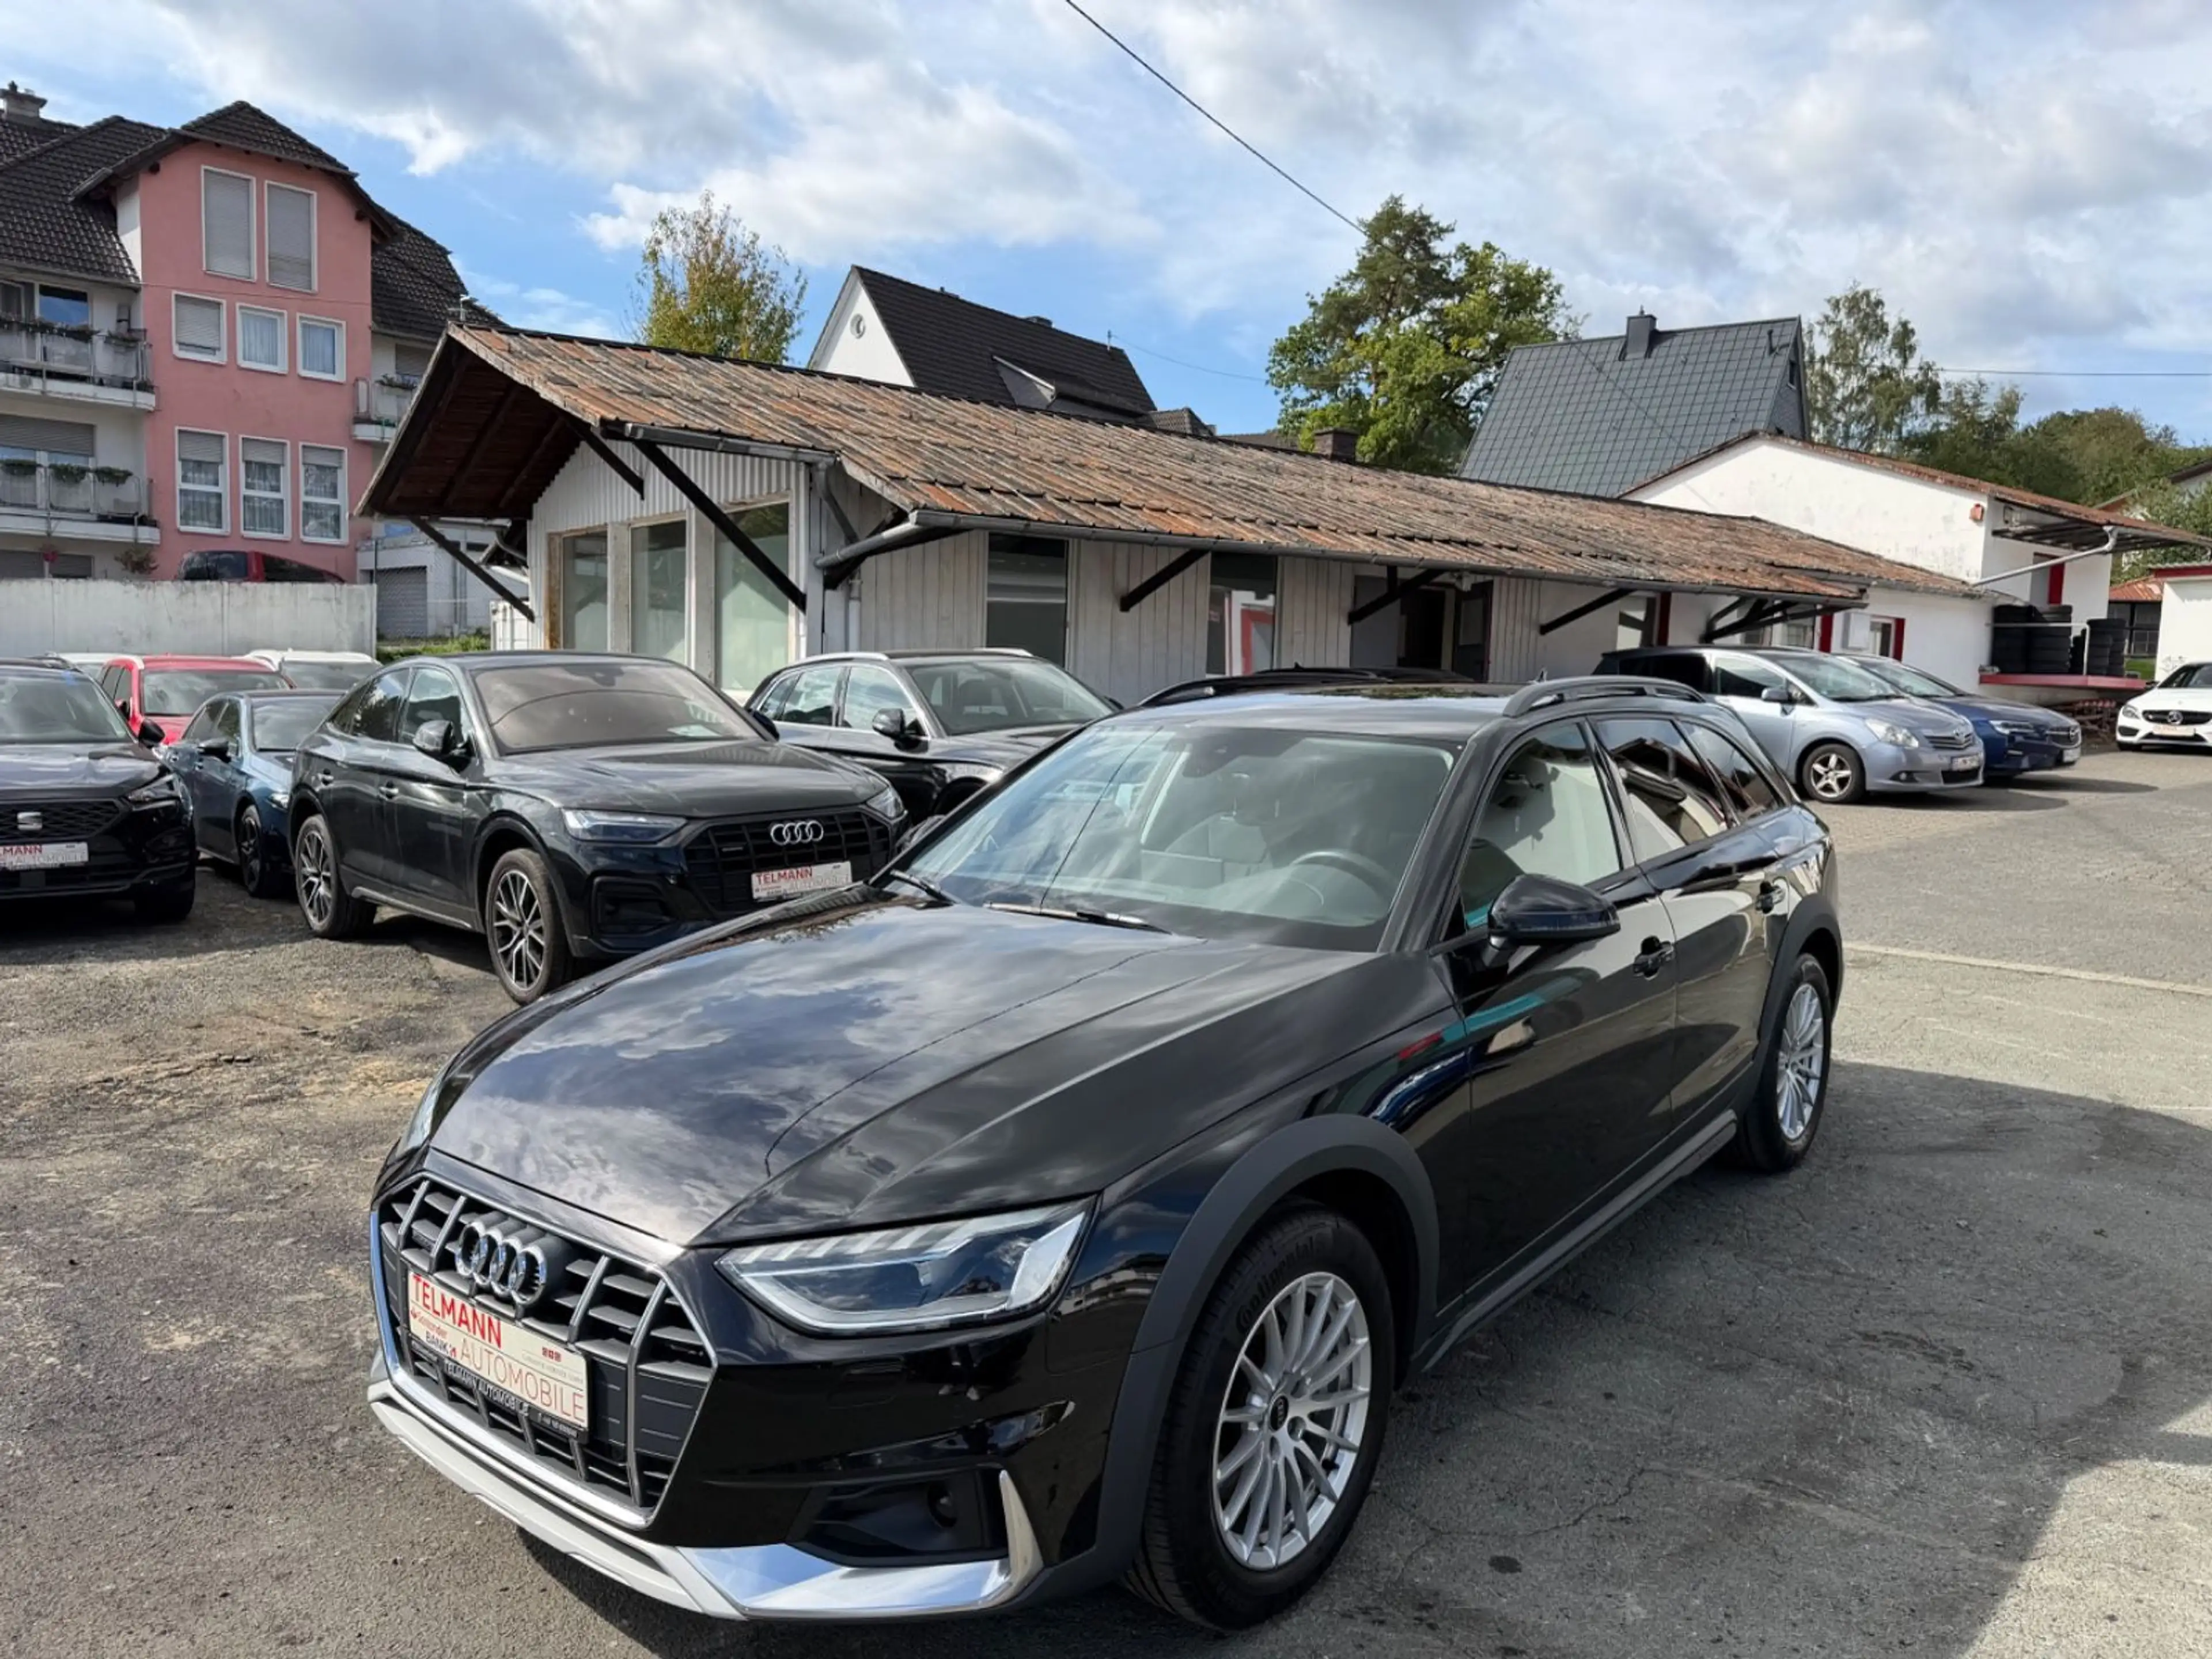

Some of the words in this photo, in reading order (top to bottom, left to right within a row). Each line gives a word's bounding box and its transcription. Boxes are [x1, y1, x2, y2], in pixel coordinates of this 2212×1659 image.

[0, 845, 42, 856] MANN
[756, 866, 813, 885] TELMANN
[413, 1274, 502, 1349] TELMANN
[461, 1338, 584, 1422] AUTOMOBILE
